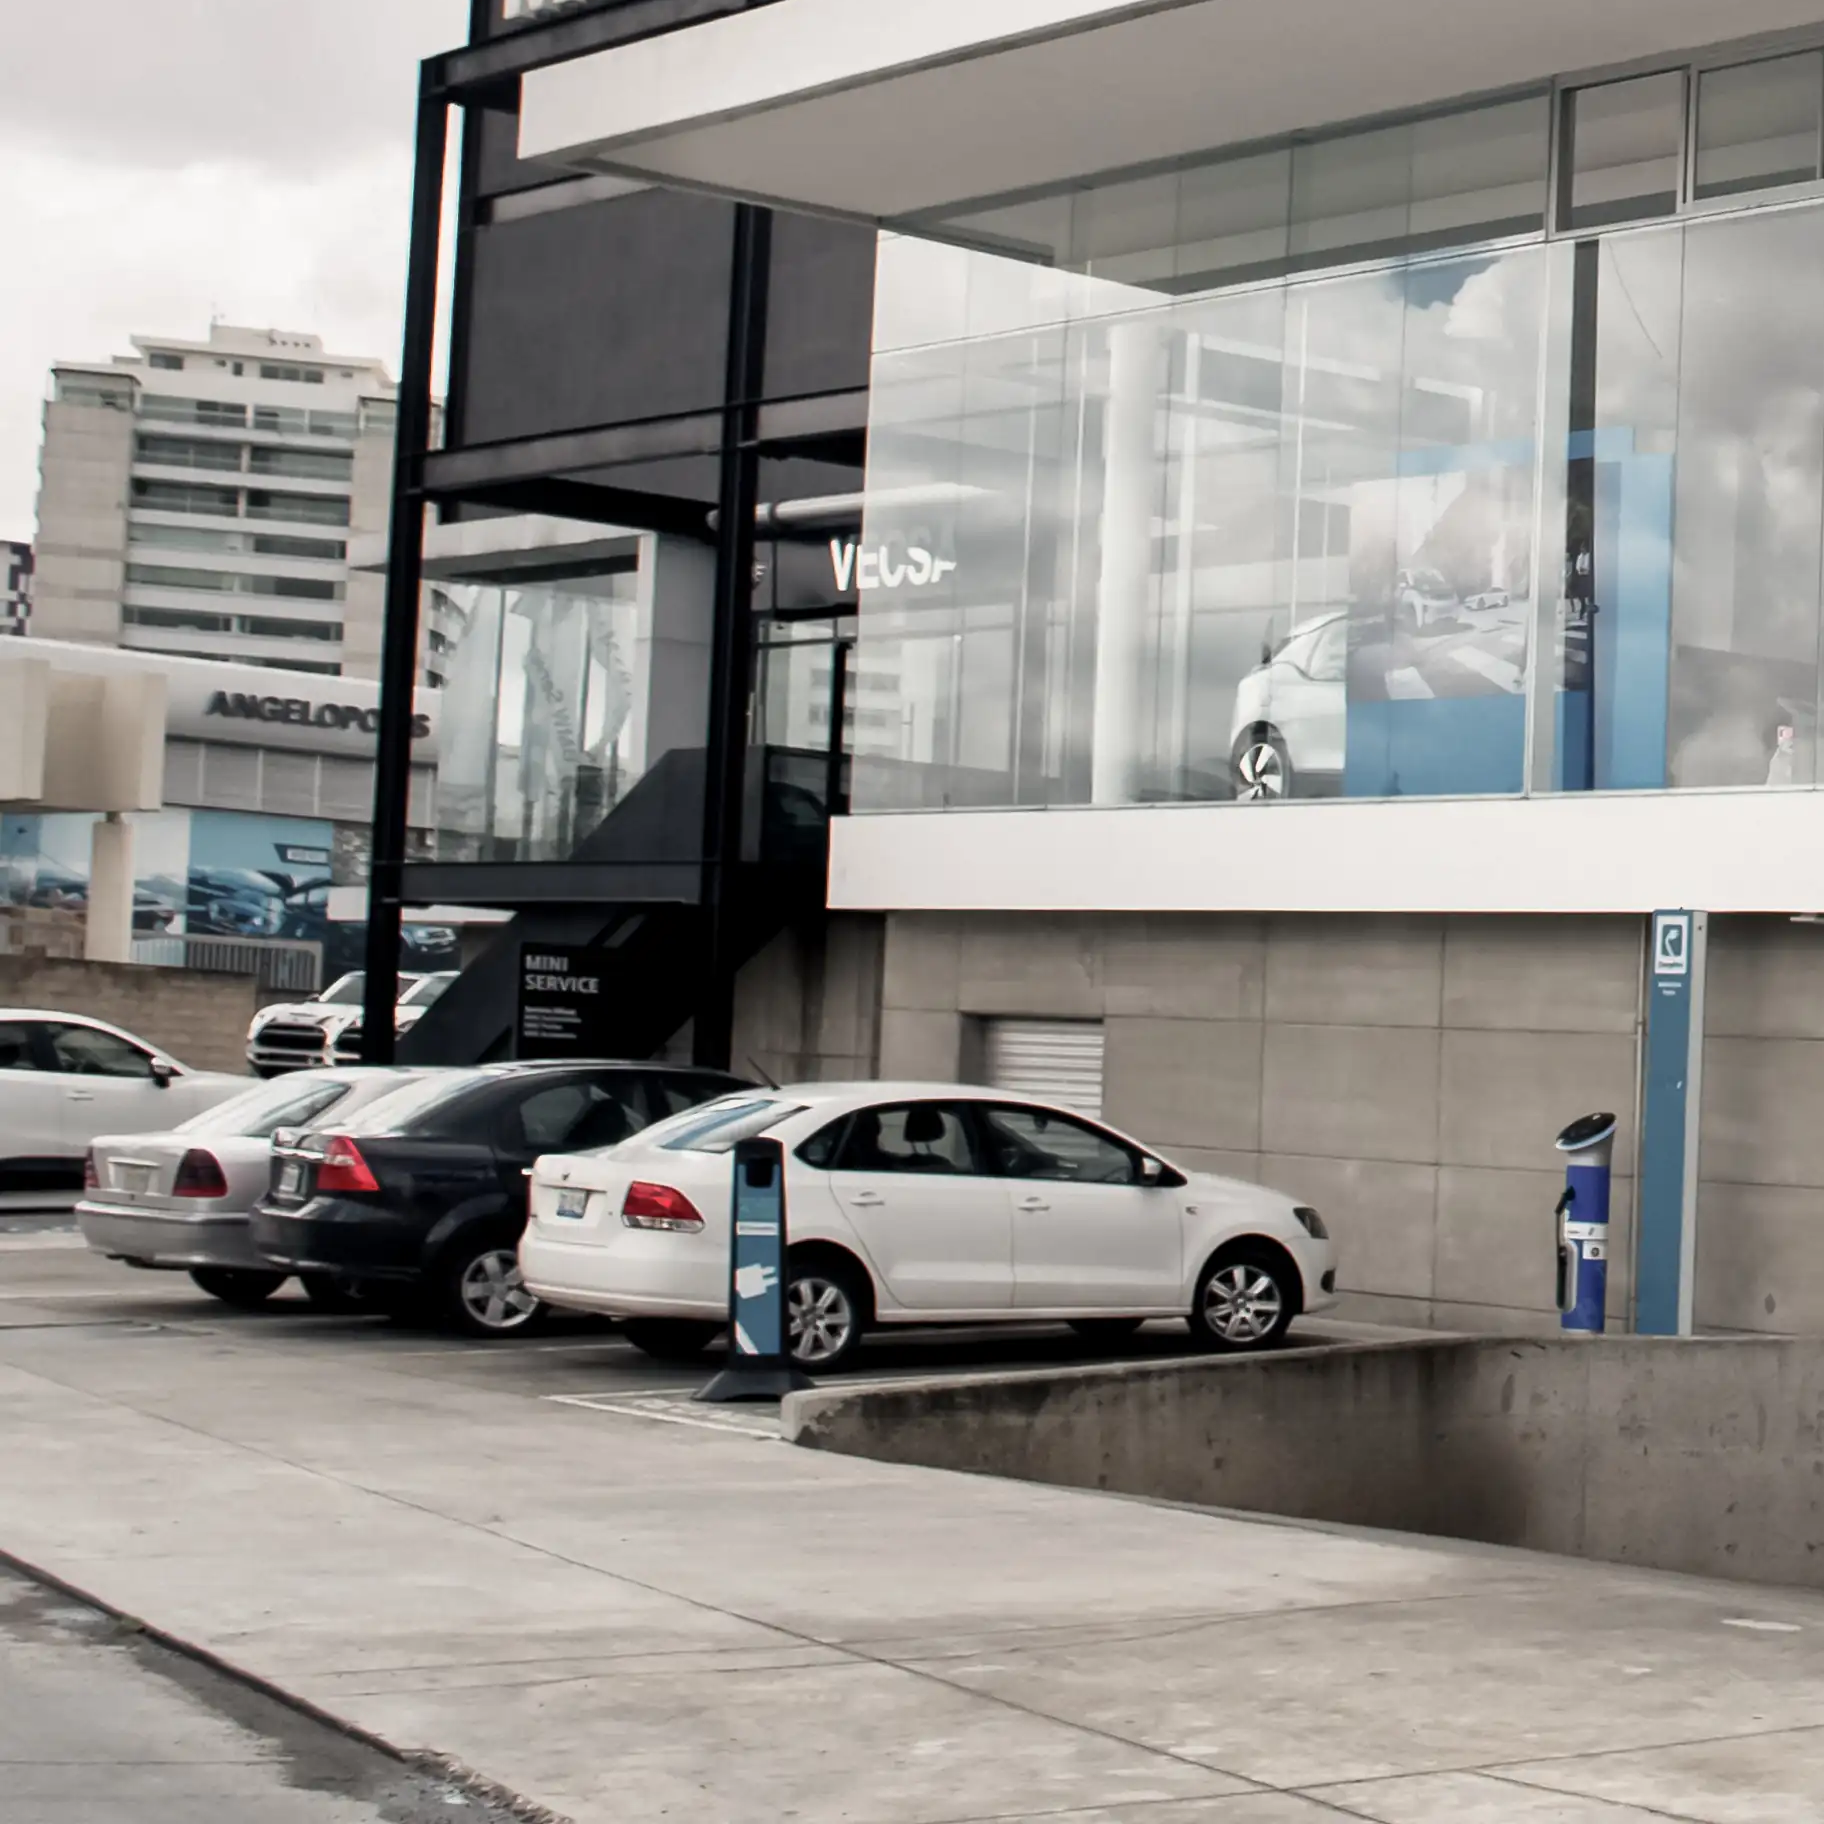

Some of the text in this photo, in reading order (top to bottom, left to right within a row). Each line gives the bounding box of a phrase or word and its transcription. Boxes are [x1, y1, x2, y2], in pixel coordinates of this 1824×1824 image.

[206, 690, 431, 739] ANGELOPOS
[525, 954, 568, 972] MINI
[525, 974, 600, 994] SERVICE
